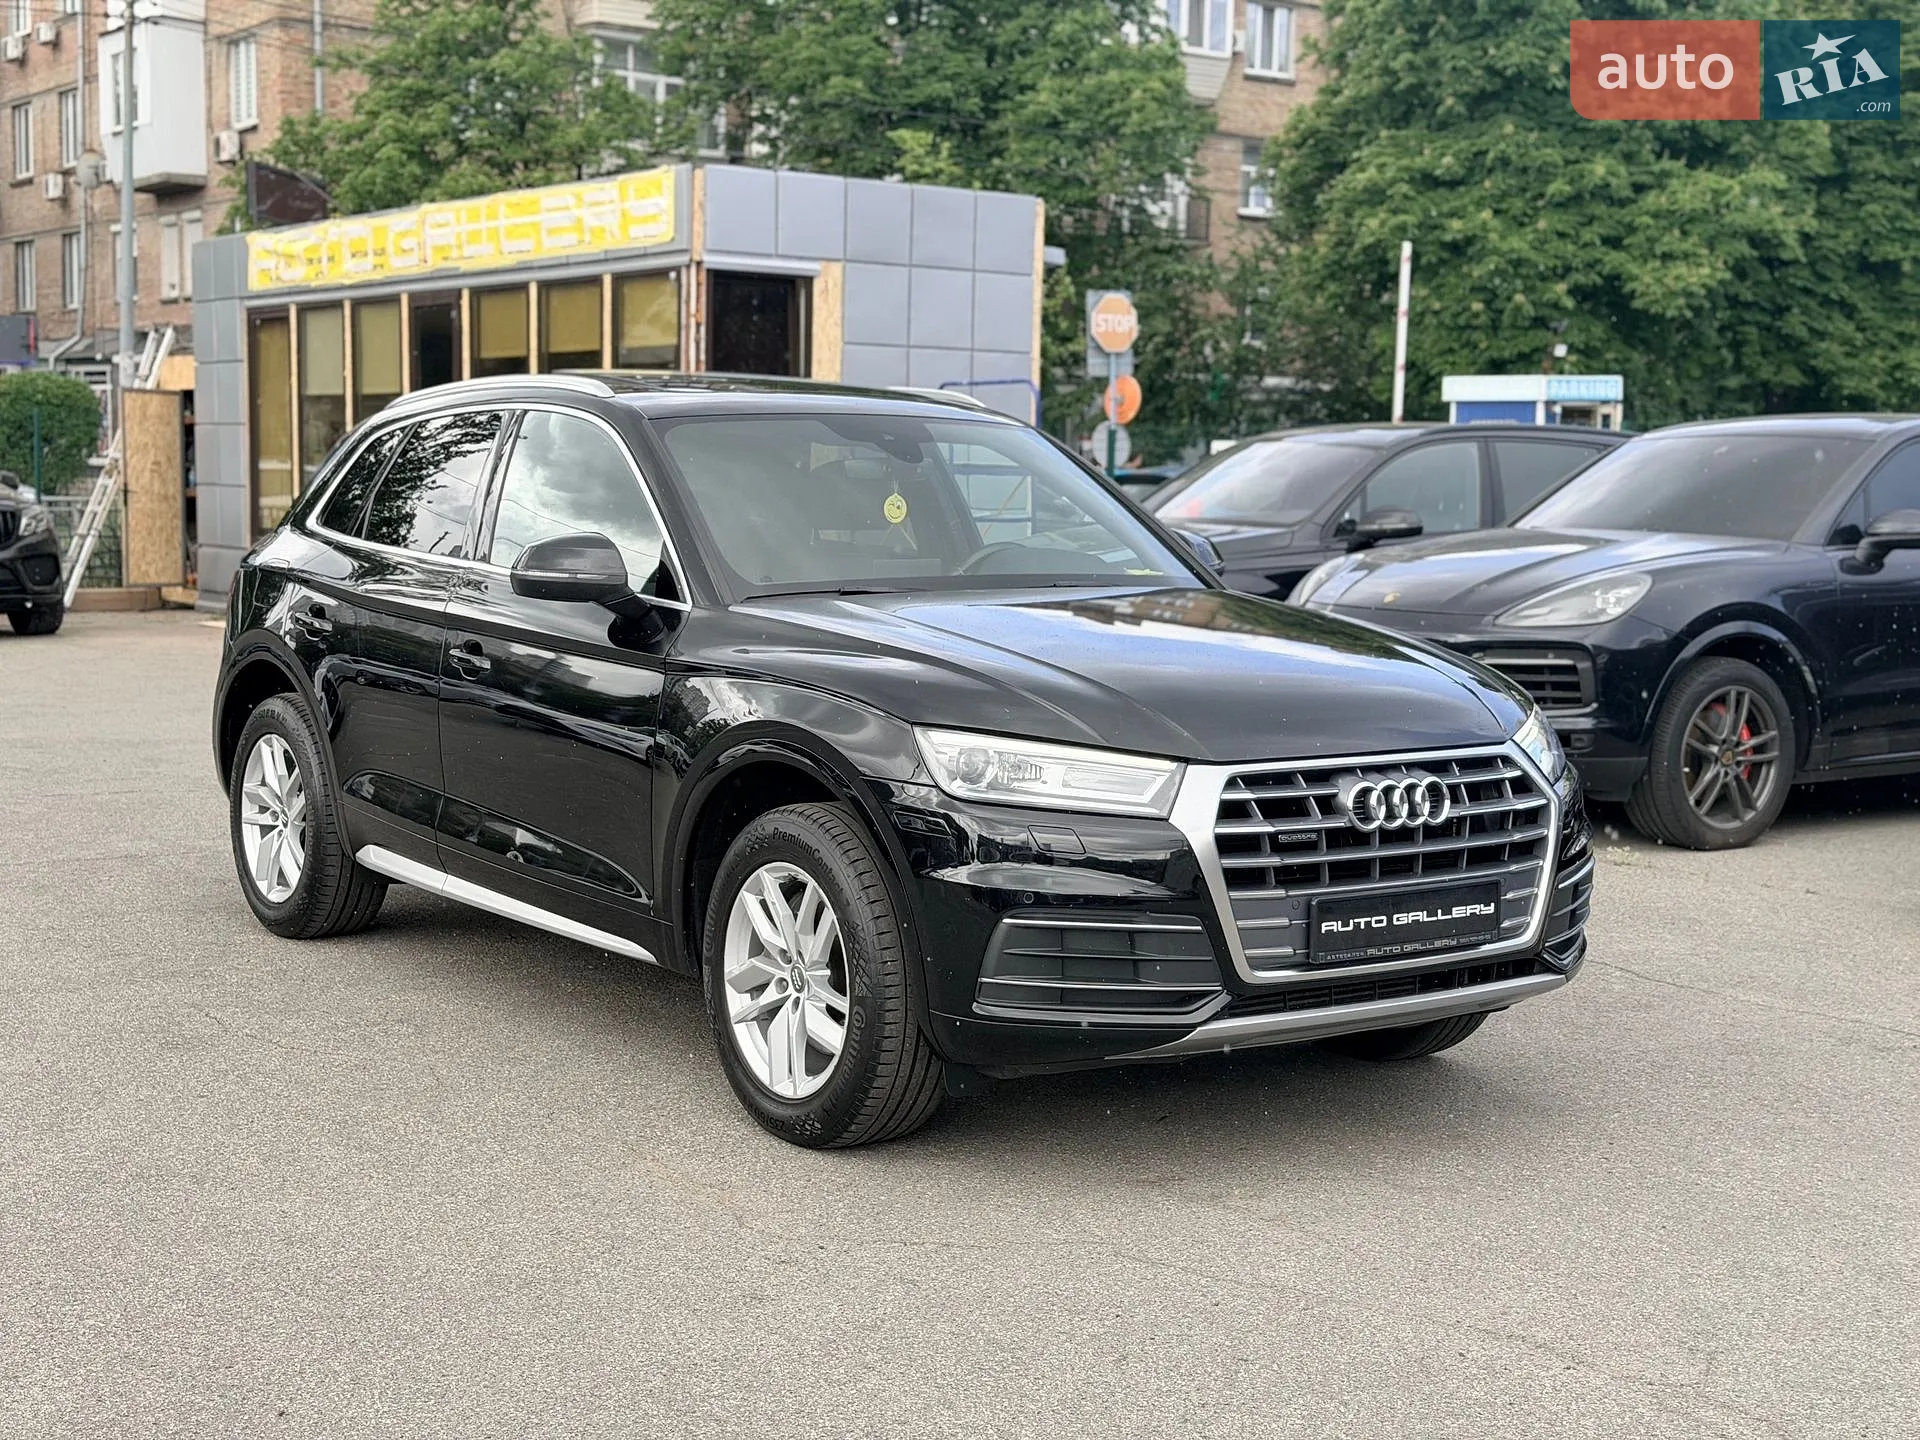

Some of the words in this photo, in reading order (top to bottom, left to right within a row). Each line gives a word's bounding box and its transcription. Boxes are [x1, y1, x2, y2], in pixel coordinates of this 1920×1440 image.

[1095, 313, 1135, 333] STOP
[1321, 915, 1387, 934] AUTO
[1393, 902, 1495, 926] GALLERY
[1366, 946, 1401, 956] AUTO
[1403, 938, 1457, 951] GALLERY
